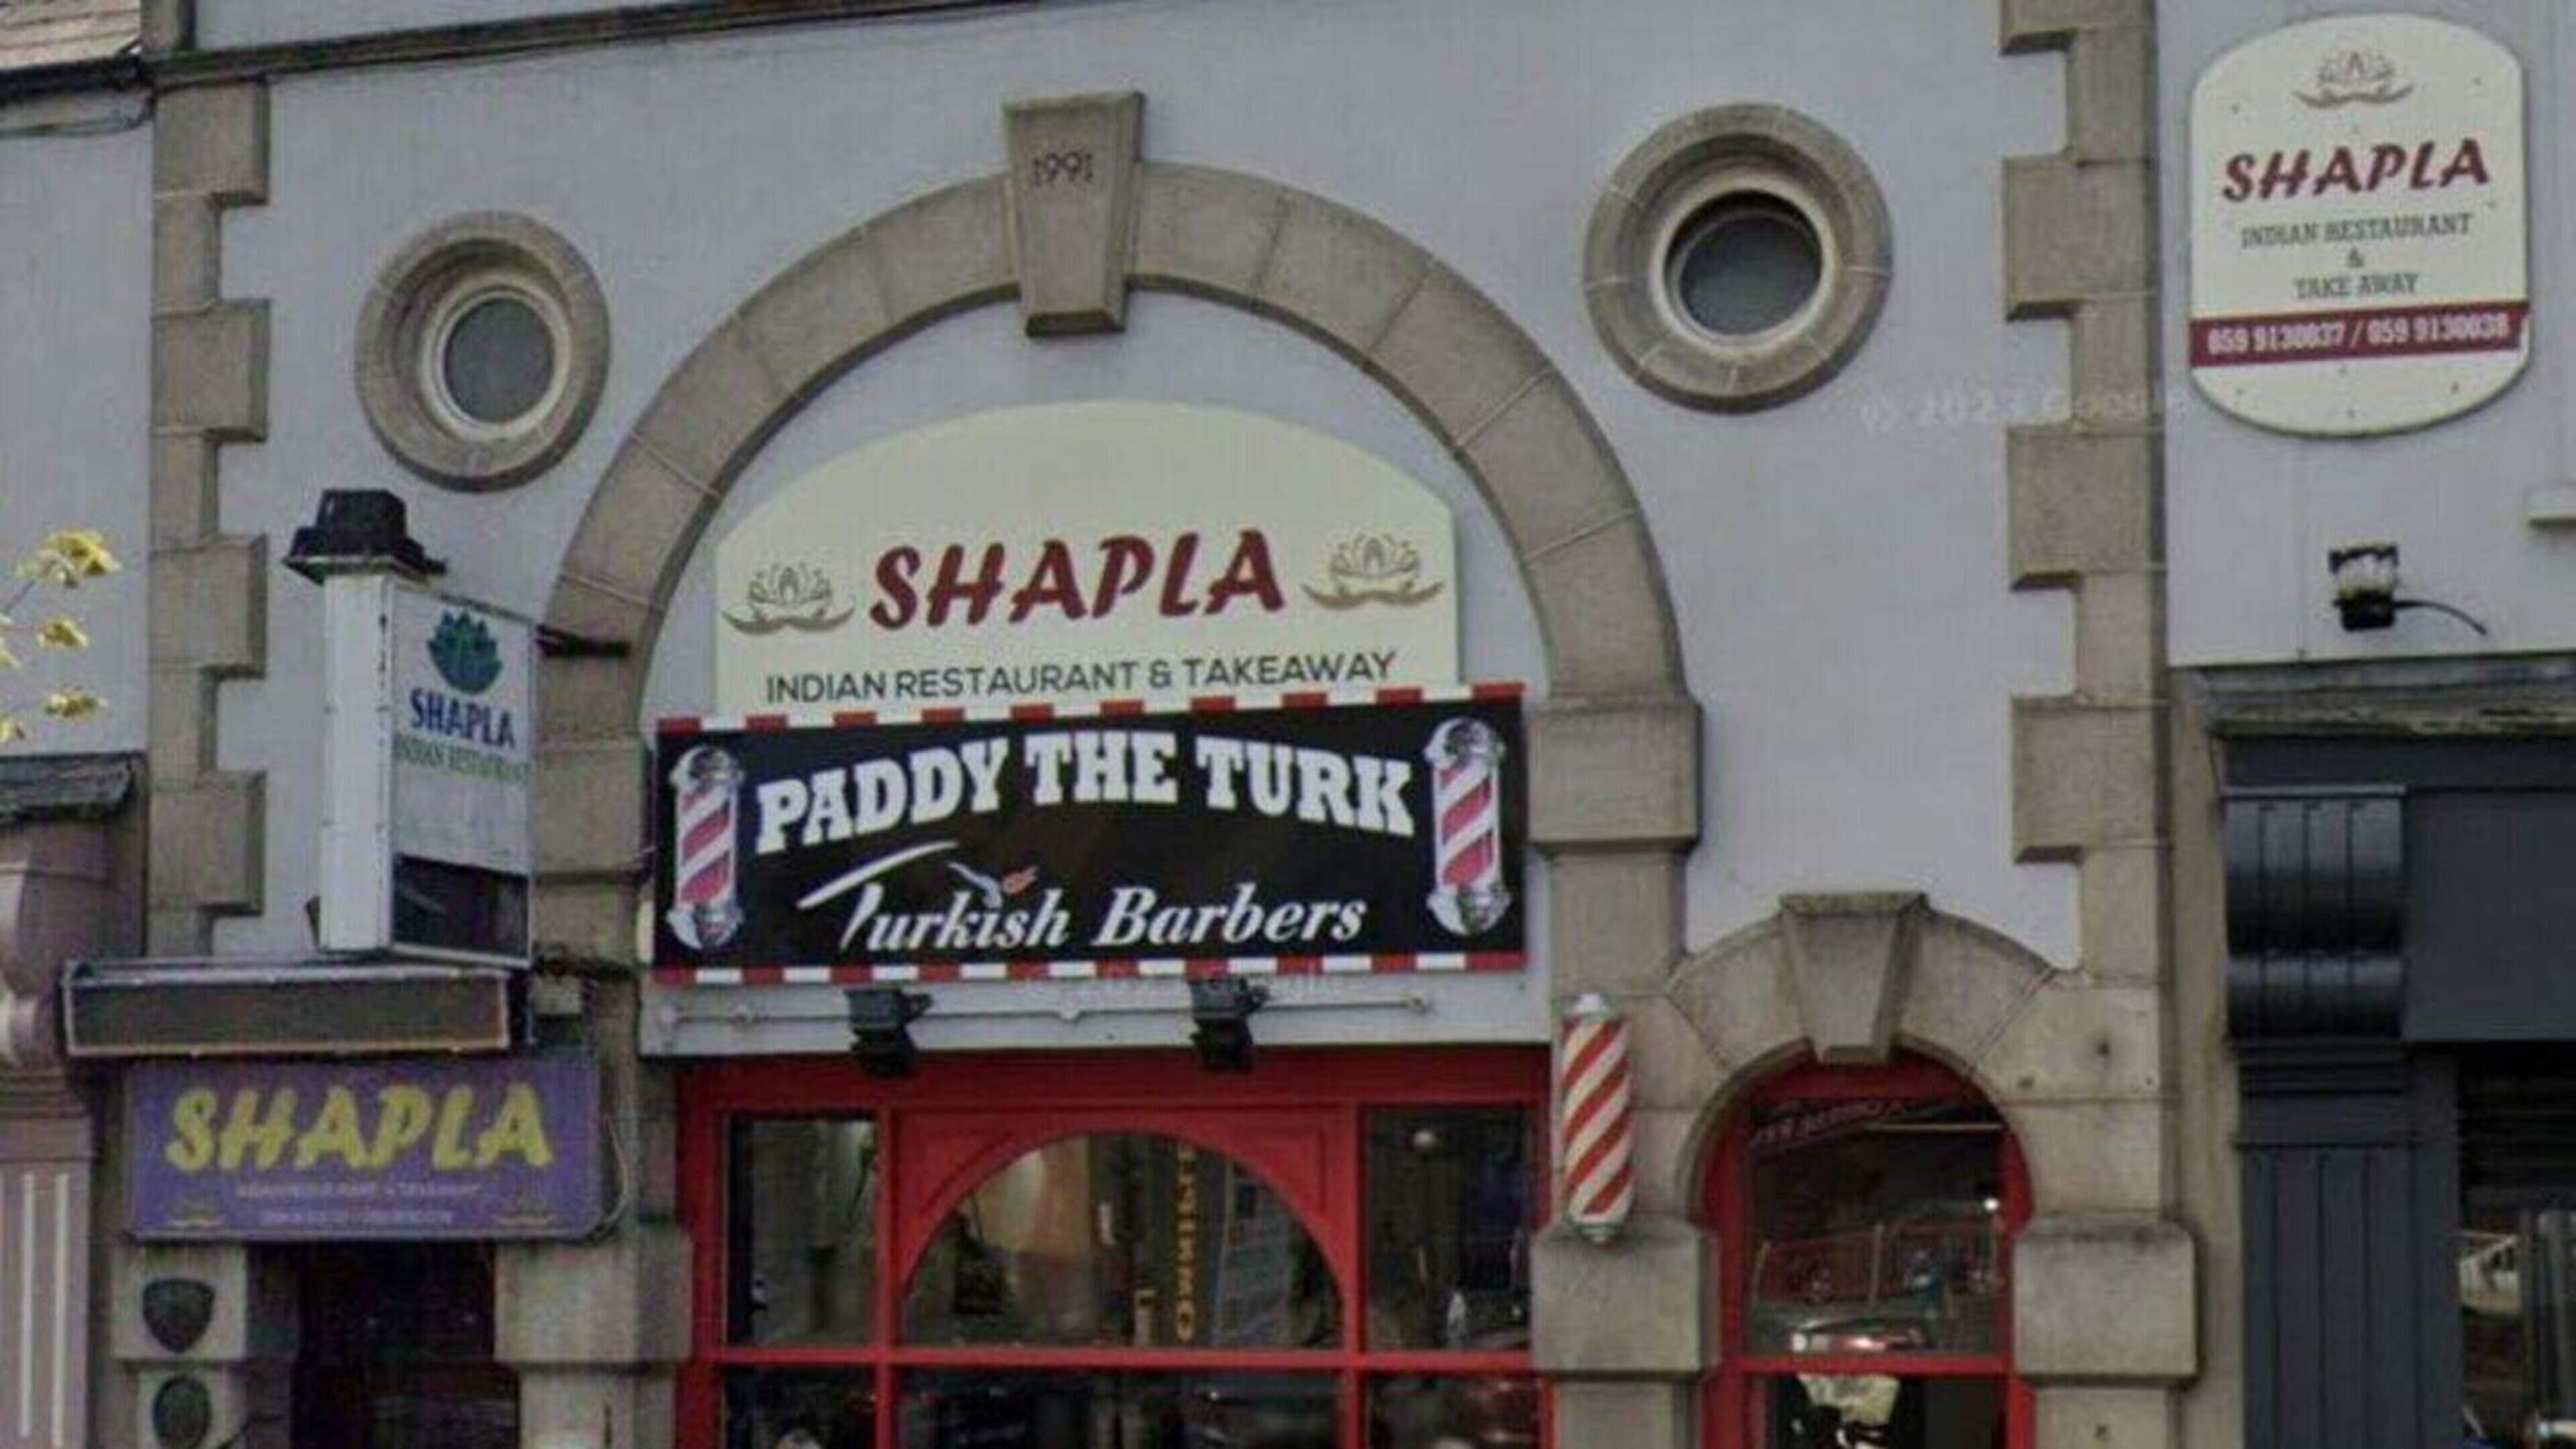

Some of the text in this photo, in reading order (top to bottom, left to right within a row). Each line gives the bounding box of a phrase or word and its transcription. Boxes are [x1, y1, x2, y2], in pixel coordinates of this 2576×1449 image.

[1033, 150, 1093, 186] 1991
[2222, 138, 2489, 202] SHAPLA
[2241, 211, 2473, 248] INDIAN RESTAURANT
[2293, 272, 2419, 299] TAKE AWAY
[869, 529, 1285, 632] SHAPLA
[766, 651, 1397, 703] INDIAN RESTAURANT & TAKEAWAY
[410, 687, 515, 749] SHAPLA
[755, 732, 1415, 854] PADDY THE TURK
[797, 840, 1367, 955] Turkish Barbers
[165, 1083, 554, 1172] SHAPLA
